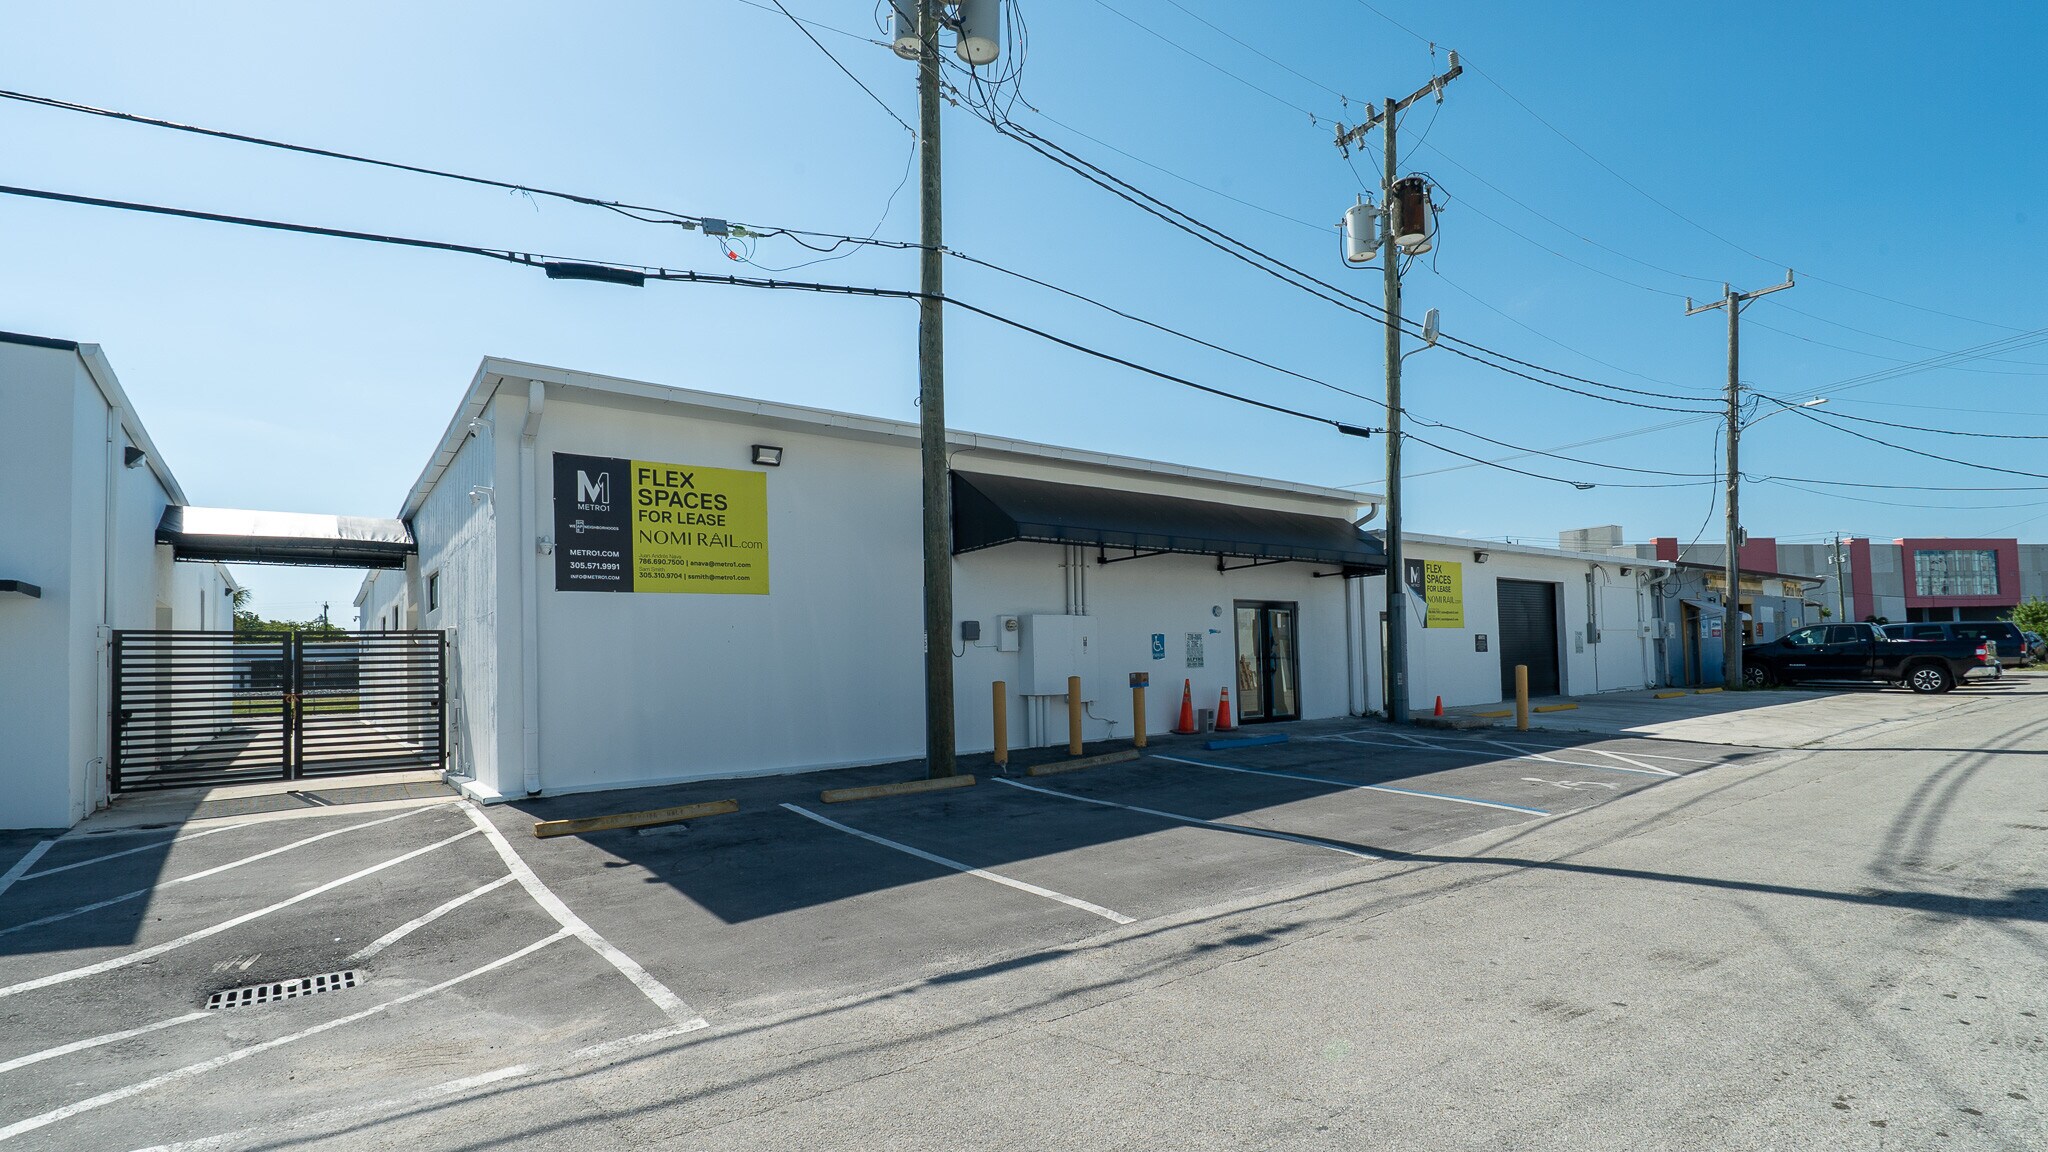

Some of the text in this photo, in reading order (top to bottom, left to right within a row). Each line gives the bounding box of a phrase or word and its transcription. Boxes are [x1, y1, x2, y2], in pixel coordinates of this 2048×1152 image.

[638, 468, 695, 489] FLEX
[638, 488, 728, 511] SPACES
[577, 503, 610, 512] METRO1
[638, 510, 726, 527] FOR LEASE
[639, 529, 692, 546] NOMI
[570, 549, 620, 558] METRO1.COM
[570, 562, 620, 570] 305.571.9991
[639, 558, 685, 566] 786.690.7500
[1426, 564, 1442, 573] FLEX
[639, 572, 683, 580] 305.310.9704
[687, 573, 751, 581] ssmith@metro1.com
[1427, 575, 1451, 584] SPACES
